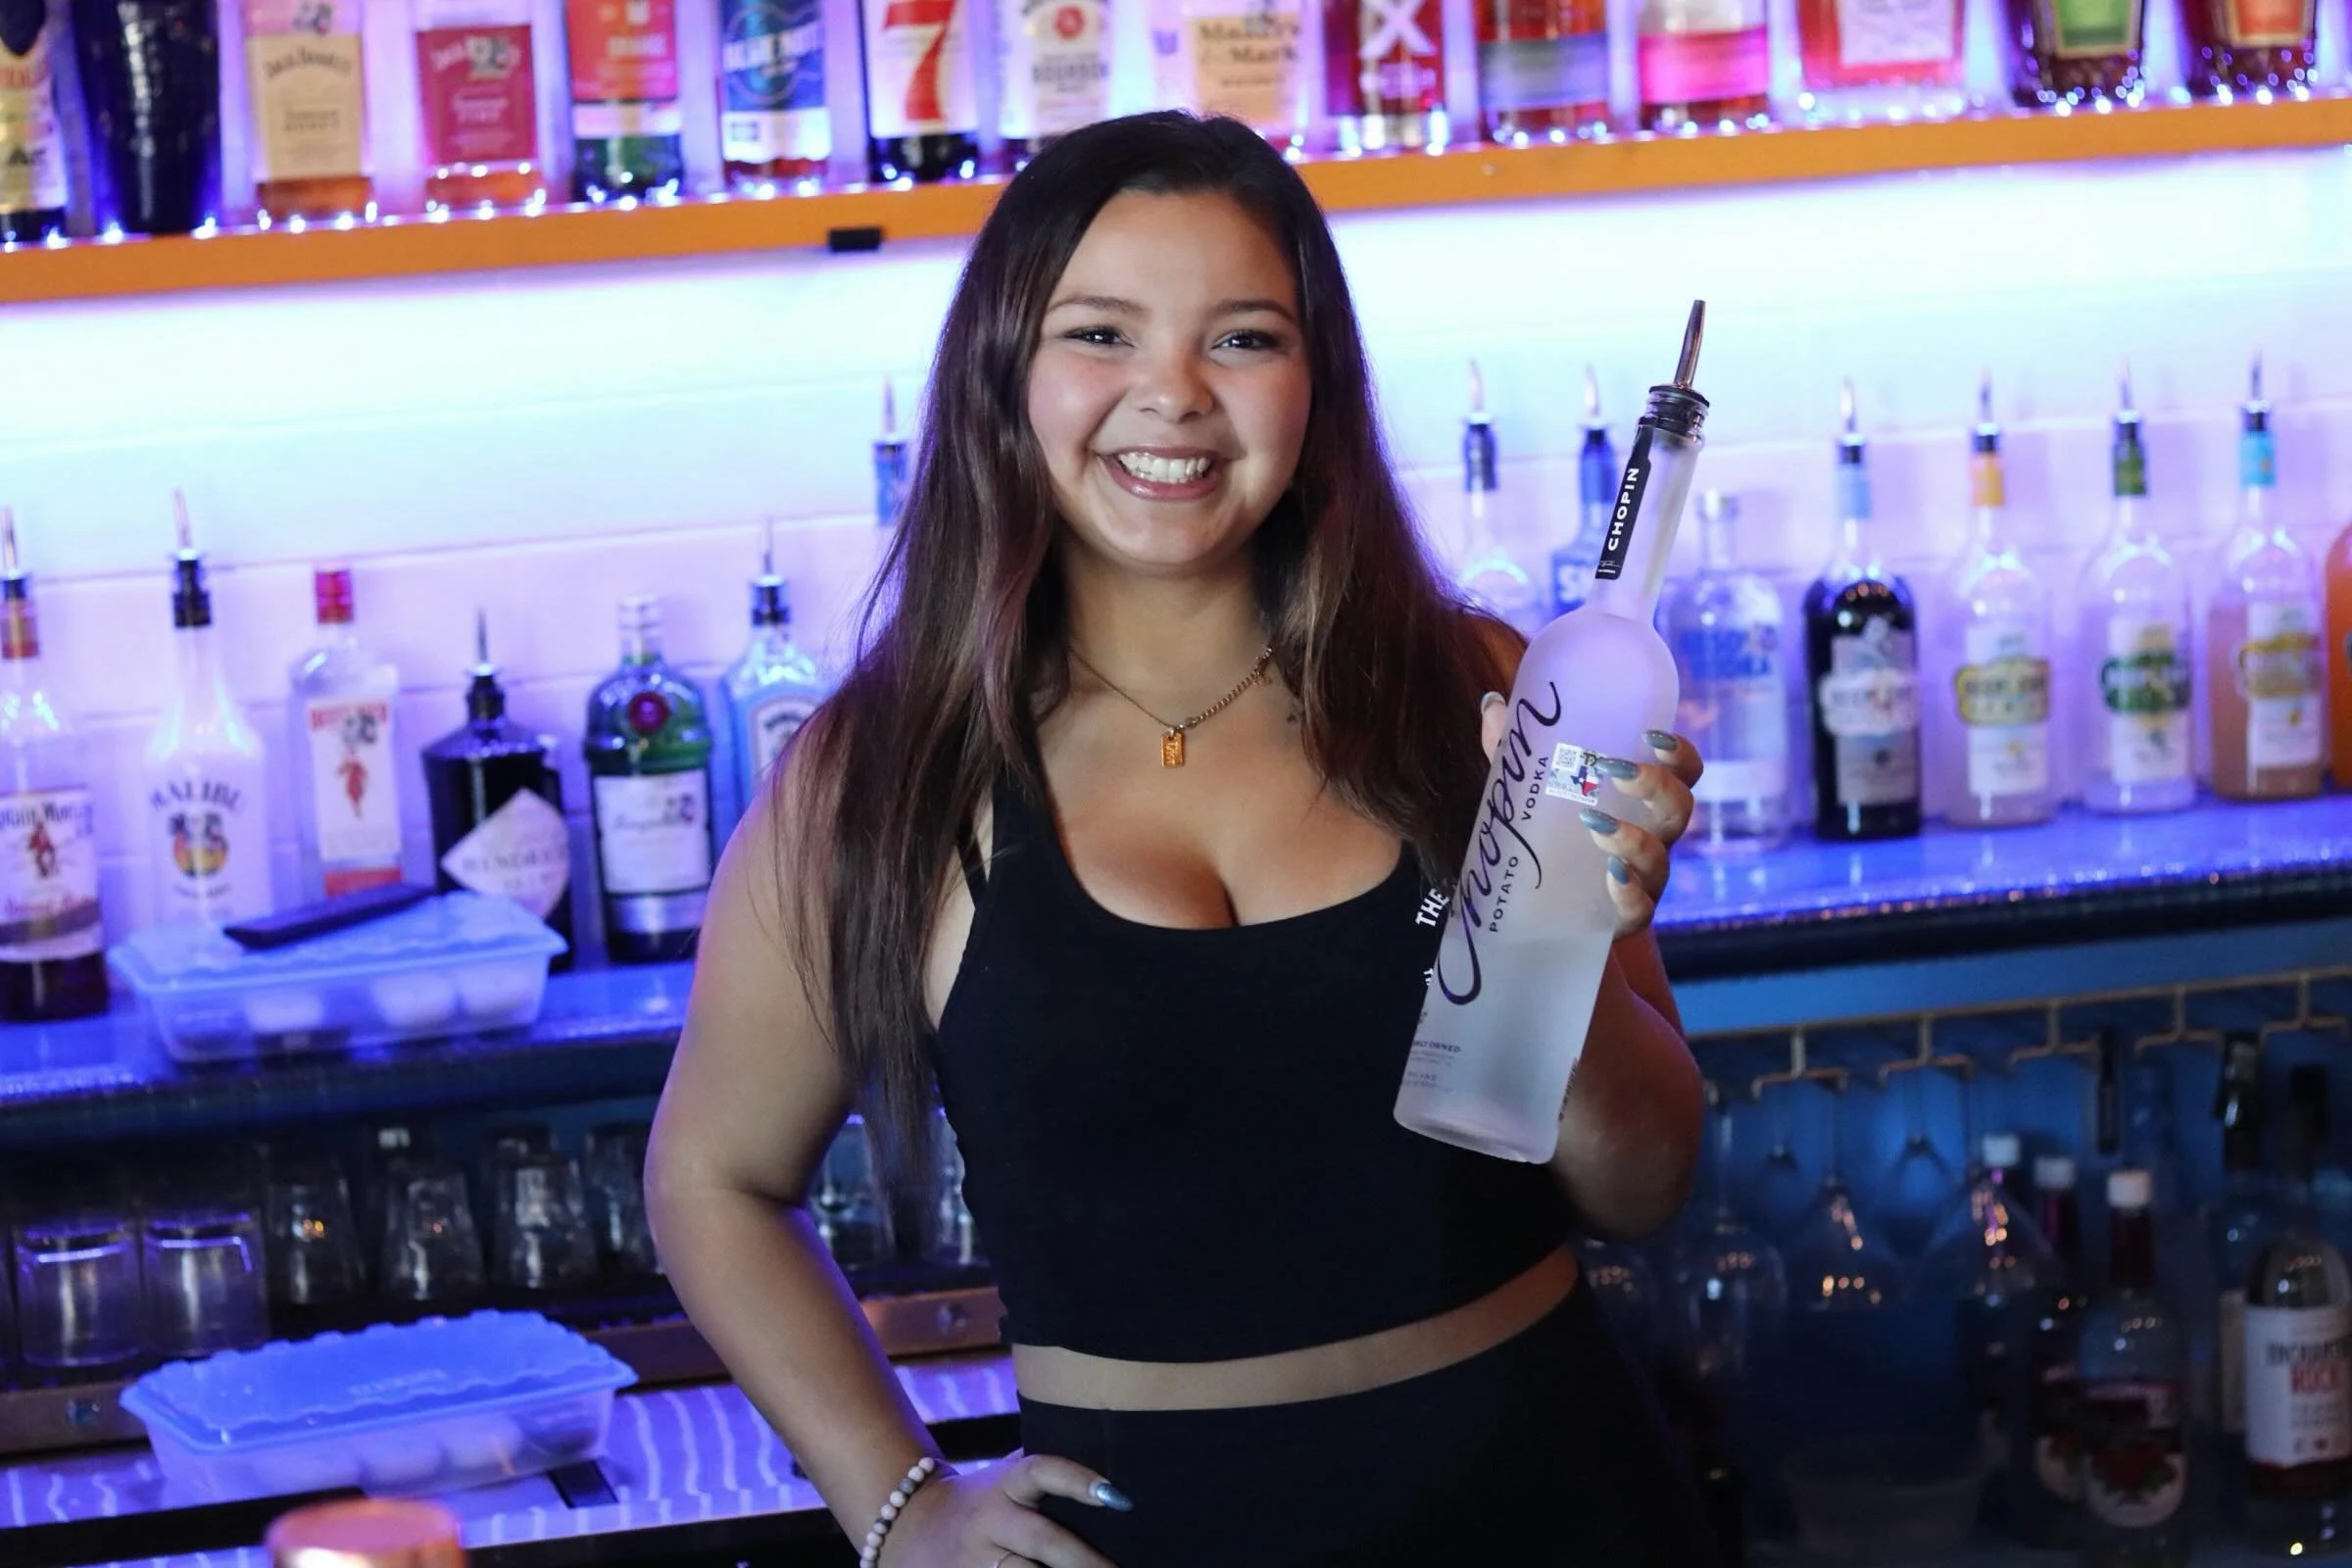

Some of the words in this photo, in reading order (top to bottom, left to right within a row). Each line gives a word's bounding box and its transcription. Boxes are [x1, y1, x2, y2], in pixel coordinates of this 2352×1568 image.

[882, 0, 957, 122] 7
[1608, 467, 1640, 551] CHOPIN
[1522, 756, 1548, 821] VODKA
[1415, 888, 1450, 927] THE
[1490, 856, 1519, 933] POTATO
